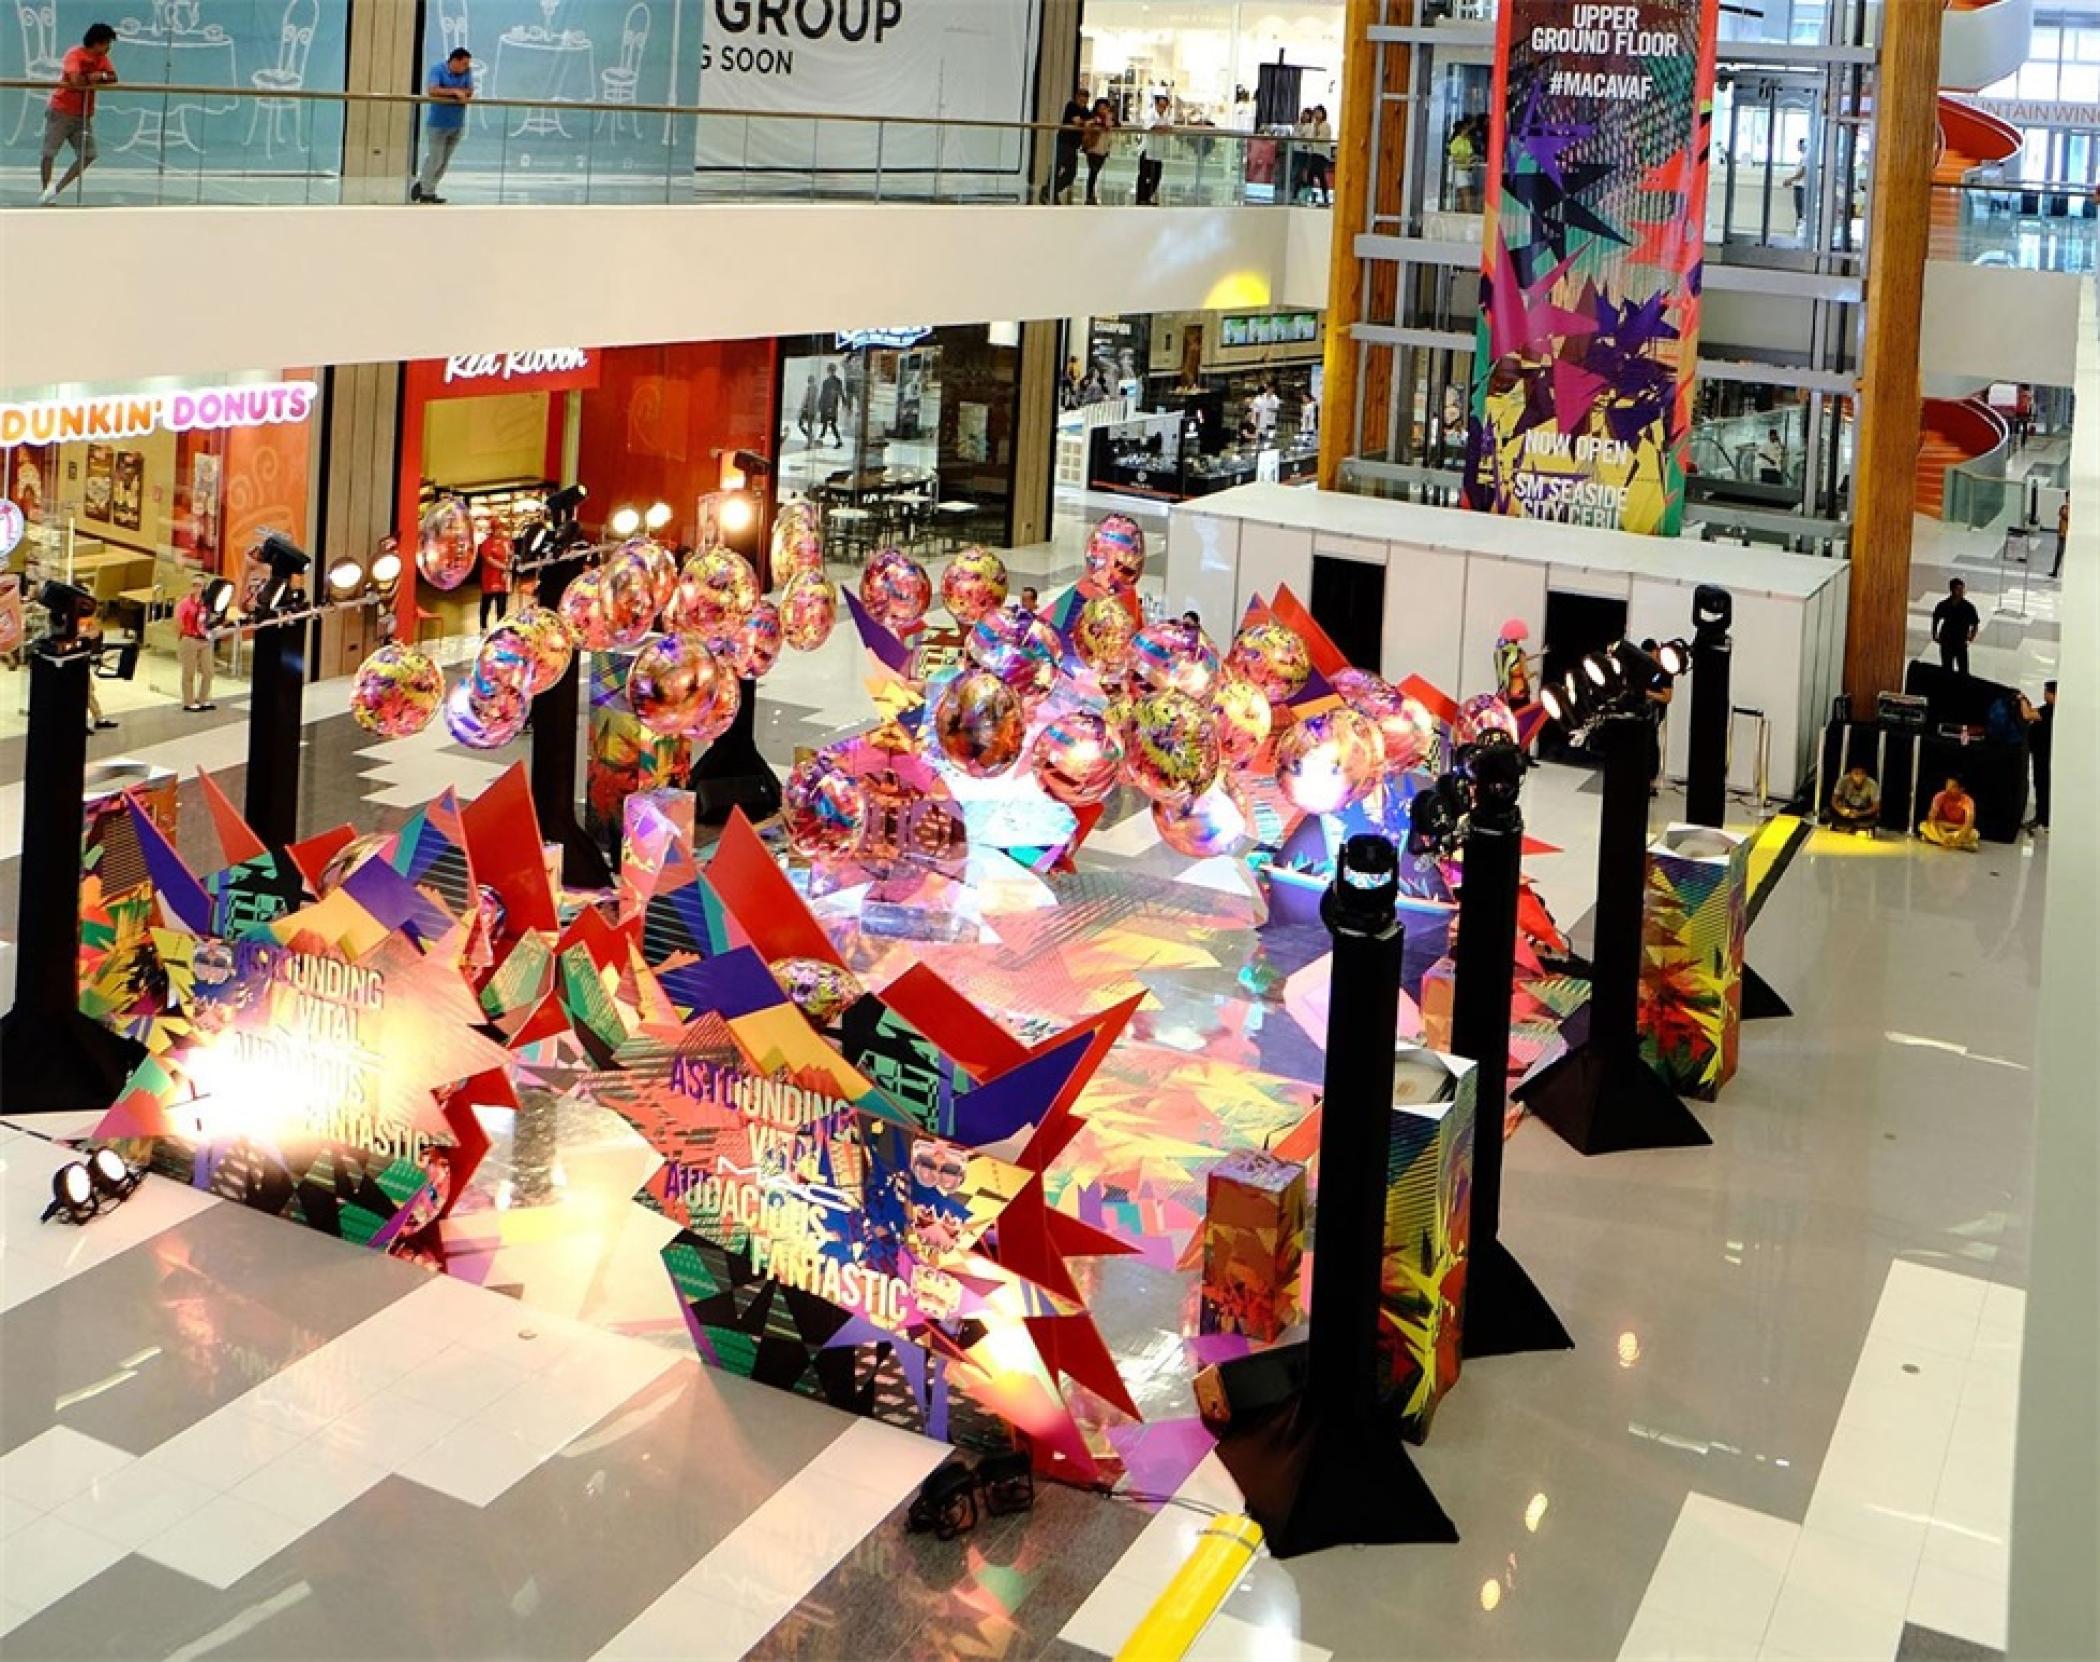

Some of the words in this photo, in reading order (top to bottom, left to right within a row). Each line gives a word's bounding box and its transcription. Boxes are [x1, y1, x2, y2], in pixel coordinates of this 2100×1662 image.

[715, 0, 902, 43] GROUP
[1572, 4, 1640, 30] UPPER
[720, 45, 793, 74] SOON
[1532, 27, 1610, 54] GROUND
[1615, 31, 1679, 57] FLOOR
[1550, 70, 1653, 100] #MACAVAF
[2054, 105, 2100, 123] WIN
[2, 399, 162, 441] DUNKIN'
[172, 388, 307, 425] DONUTS
[1526, 429, 1571, 457] NOW
[1576, 435, 1628, 465] OPEN
[1515, 472, 1544, 500] SM
[1550, 477, 1629, 511] SEASIDE
[297, 993, 363, 1046] VITAL
[751, 1236, 908, 1322] FANTASTIC
